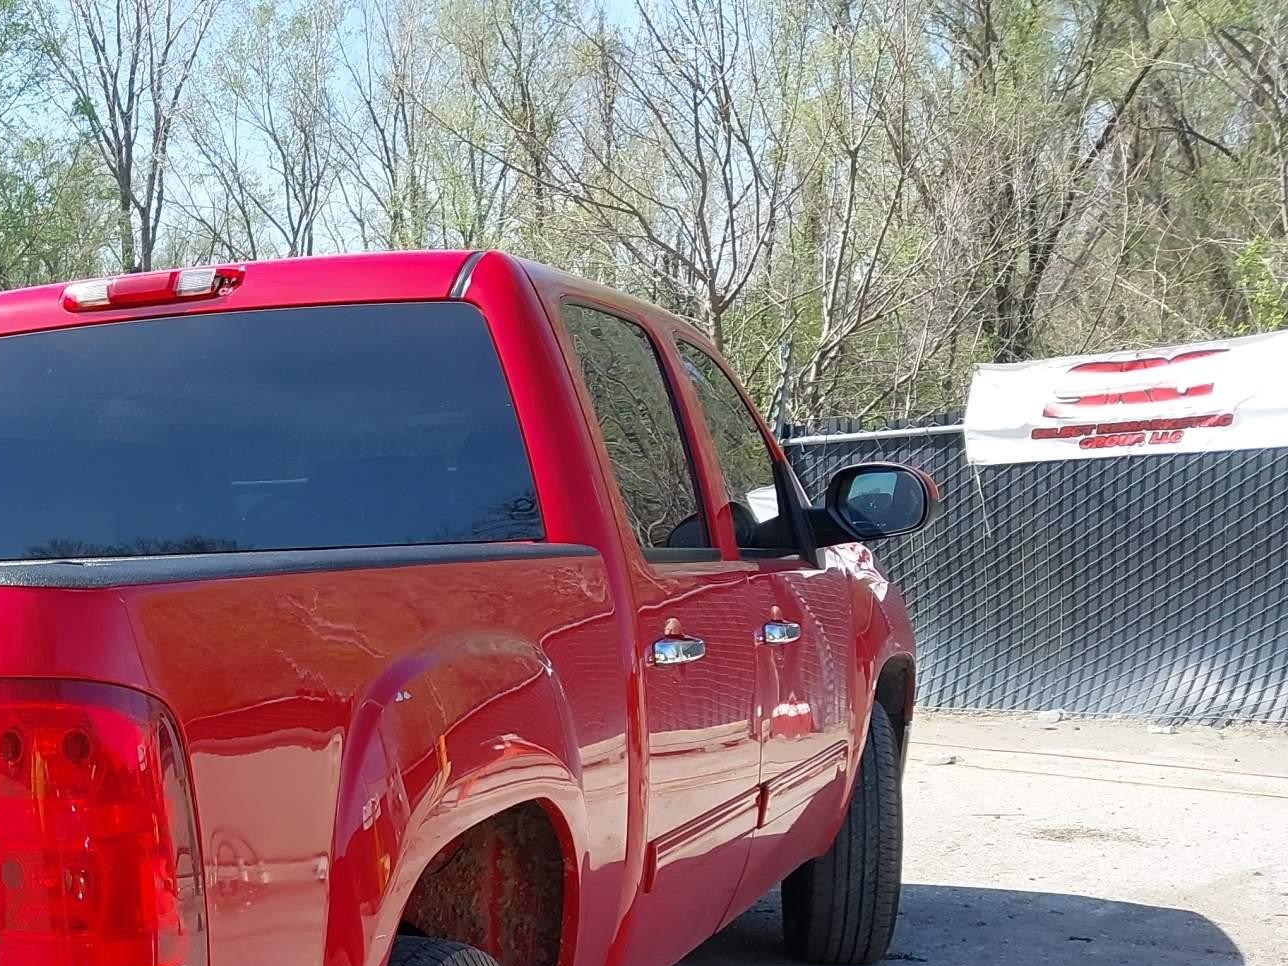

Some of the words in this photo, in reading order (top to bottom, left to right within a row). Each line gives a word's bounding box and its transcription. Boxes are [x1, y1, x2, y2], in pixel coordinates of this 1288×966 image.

[1031, 424, 1097, 440] SELECT
[1096, 413, 1234, 435] REMARKETING
[1148, 430, 1184, 445] LLC
